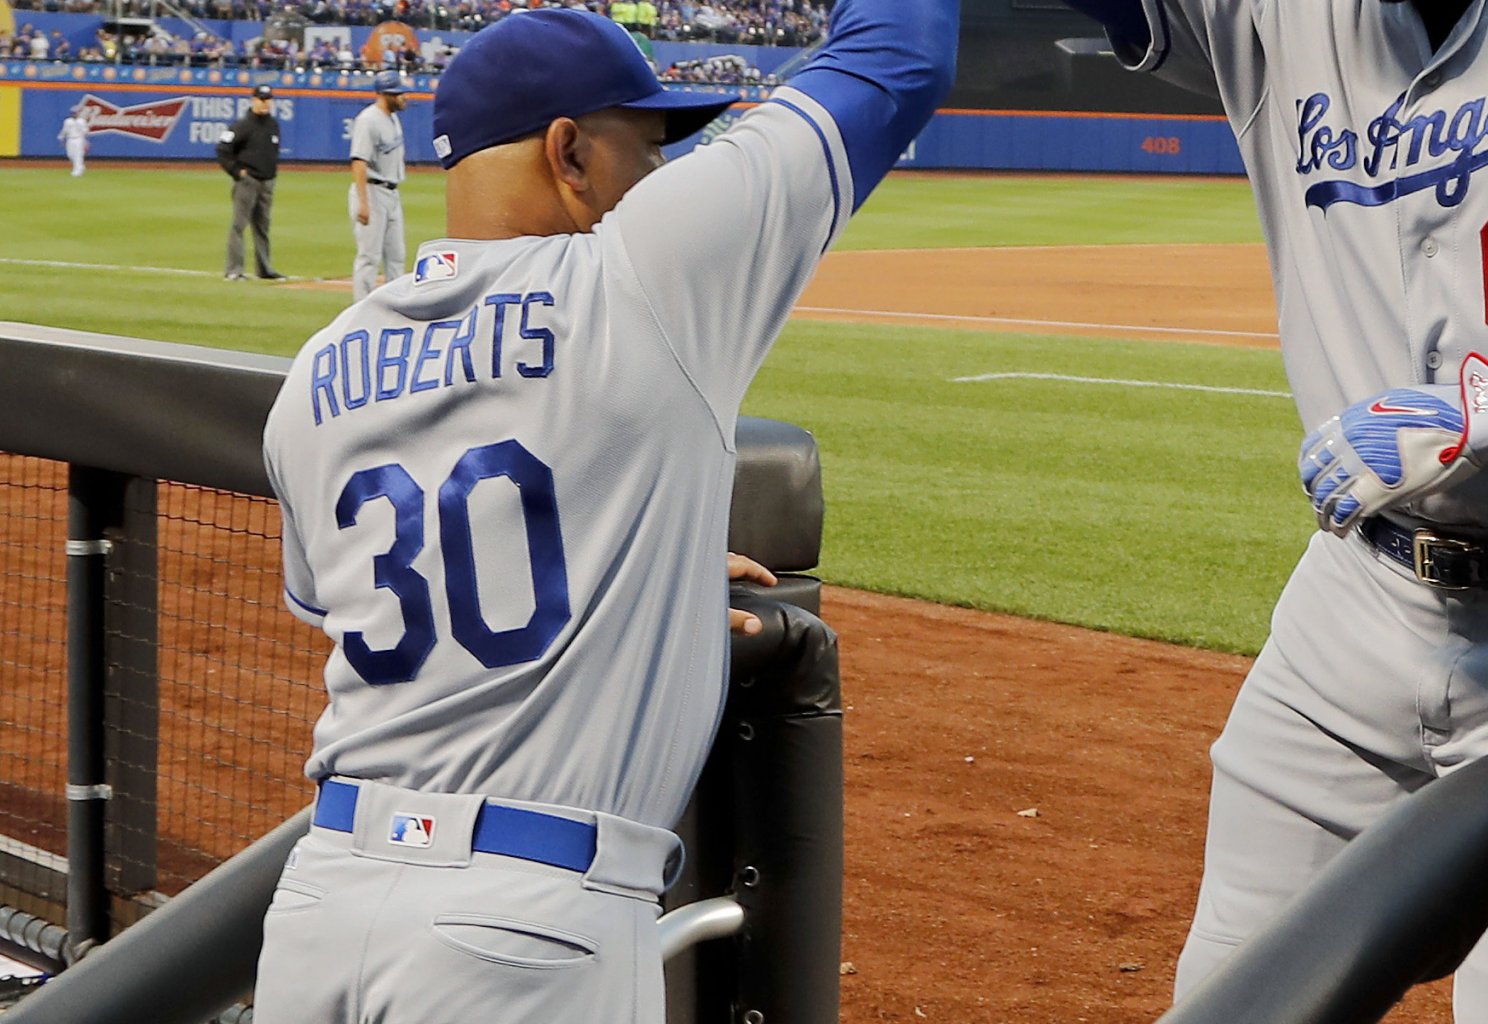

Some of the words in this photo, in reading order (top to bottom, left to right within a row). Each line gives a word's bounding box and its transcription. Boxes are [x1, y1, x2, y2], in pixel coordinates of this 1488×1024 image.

[192, 95, 234, 120] THIS
[1141, 136, 1182, 154] 408
[1296, 92, 1358, 175] Los
[313, 291, 556, 426] ROBERTS
[335, 438, 572, 686] 30
